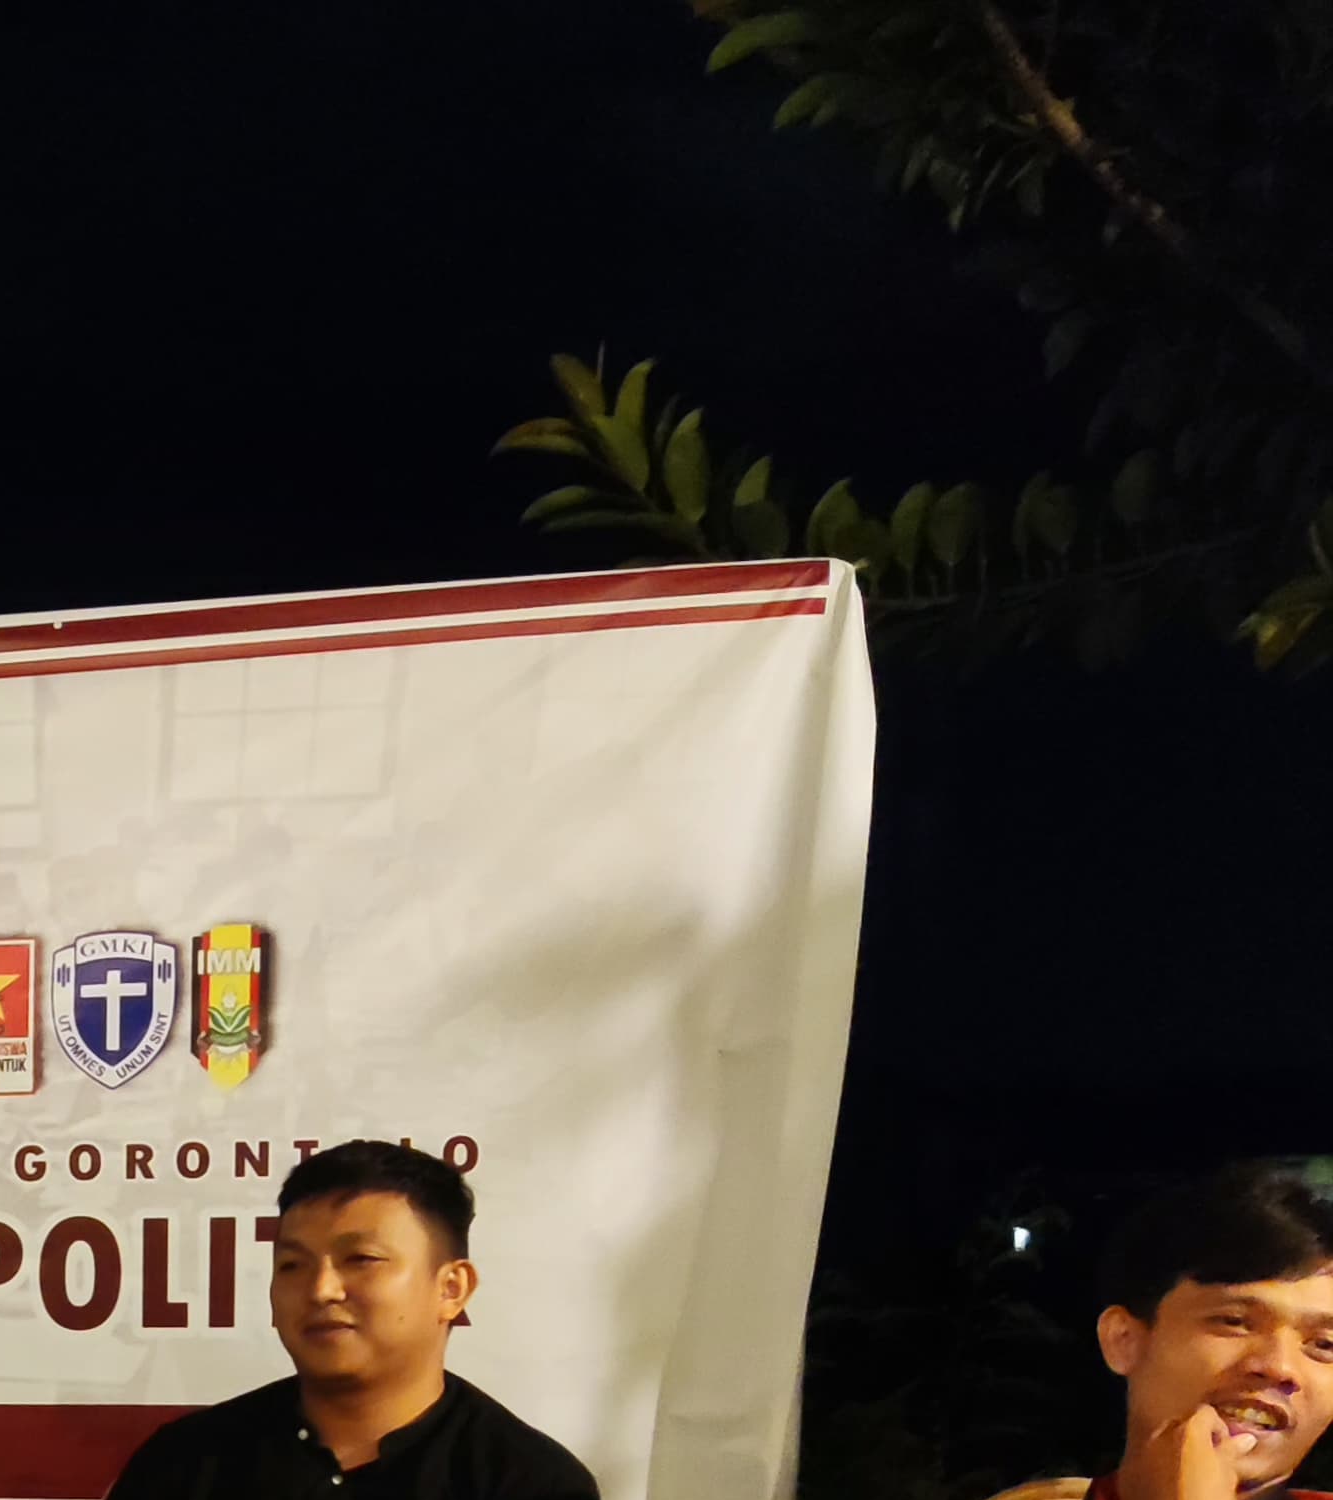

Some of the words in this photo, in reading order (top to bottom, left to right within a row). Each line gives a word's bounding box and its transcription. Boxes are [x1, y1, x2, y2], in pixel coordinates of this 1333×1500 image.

[80, 937, 148, 958] GMKI
[197, 947, 262, 976] IMM
[65, 1036, 107, 1078] OMNES
[116, 1044, 153, 1080] UNUM
[150, 1011, 169, 1046] SINT
